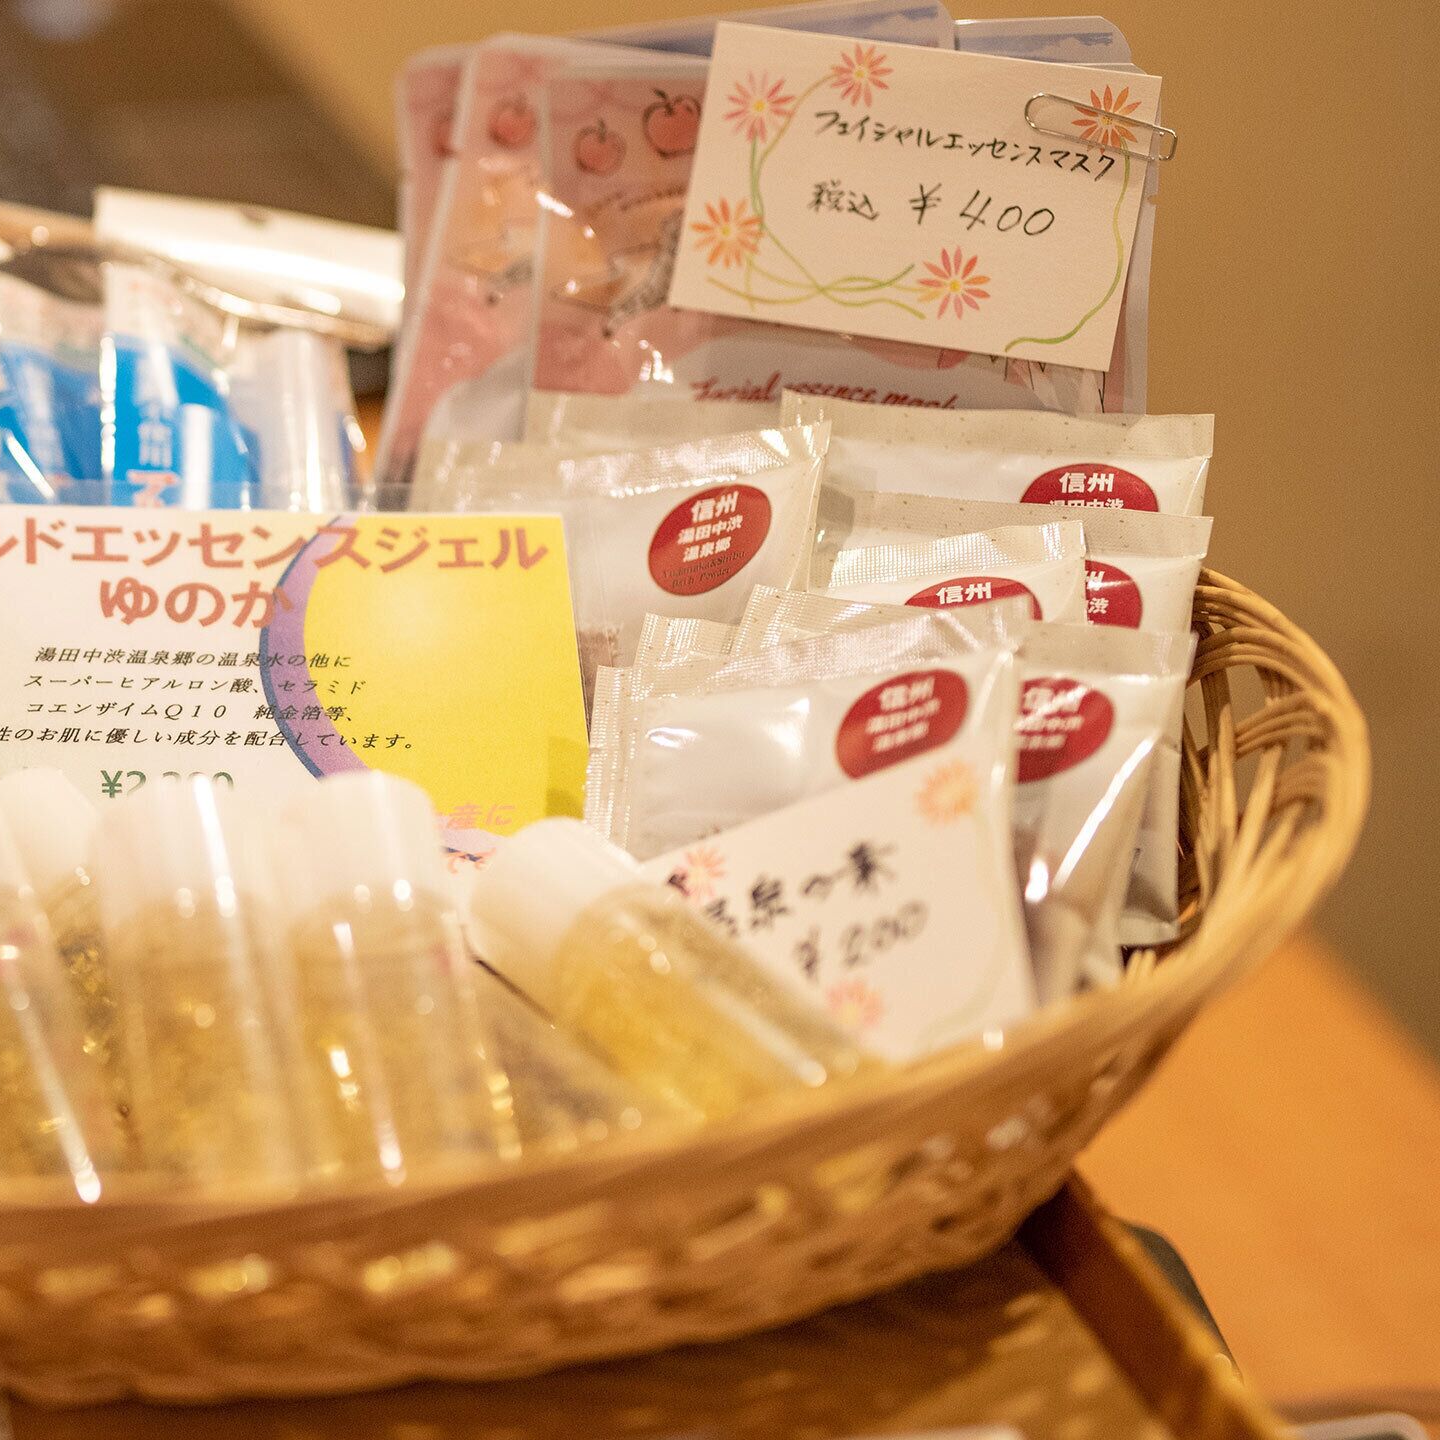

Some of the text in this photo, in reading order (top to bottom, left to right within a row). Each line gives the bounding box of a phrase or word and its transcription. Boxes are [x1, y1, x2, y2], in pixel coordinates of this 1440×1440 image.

[808, 181, 879, 221] 税込
[1058, 472, 1115, 494] 信州
[691, 490, 740, 524] 信州
[99, 580, 297, 631] ゆのか
[935, 582, 993, 605] 信州
[34, 646, 353, 670] 湯田中渋温泉郷の温泉水の他に
